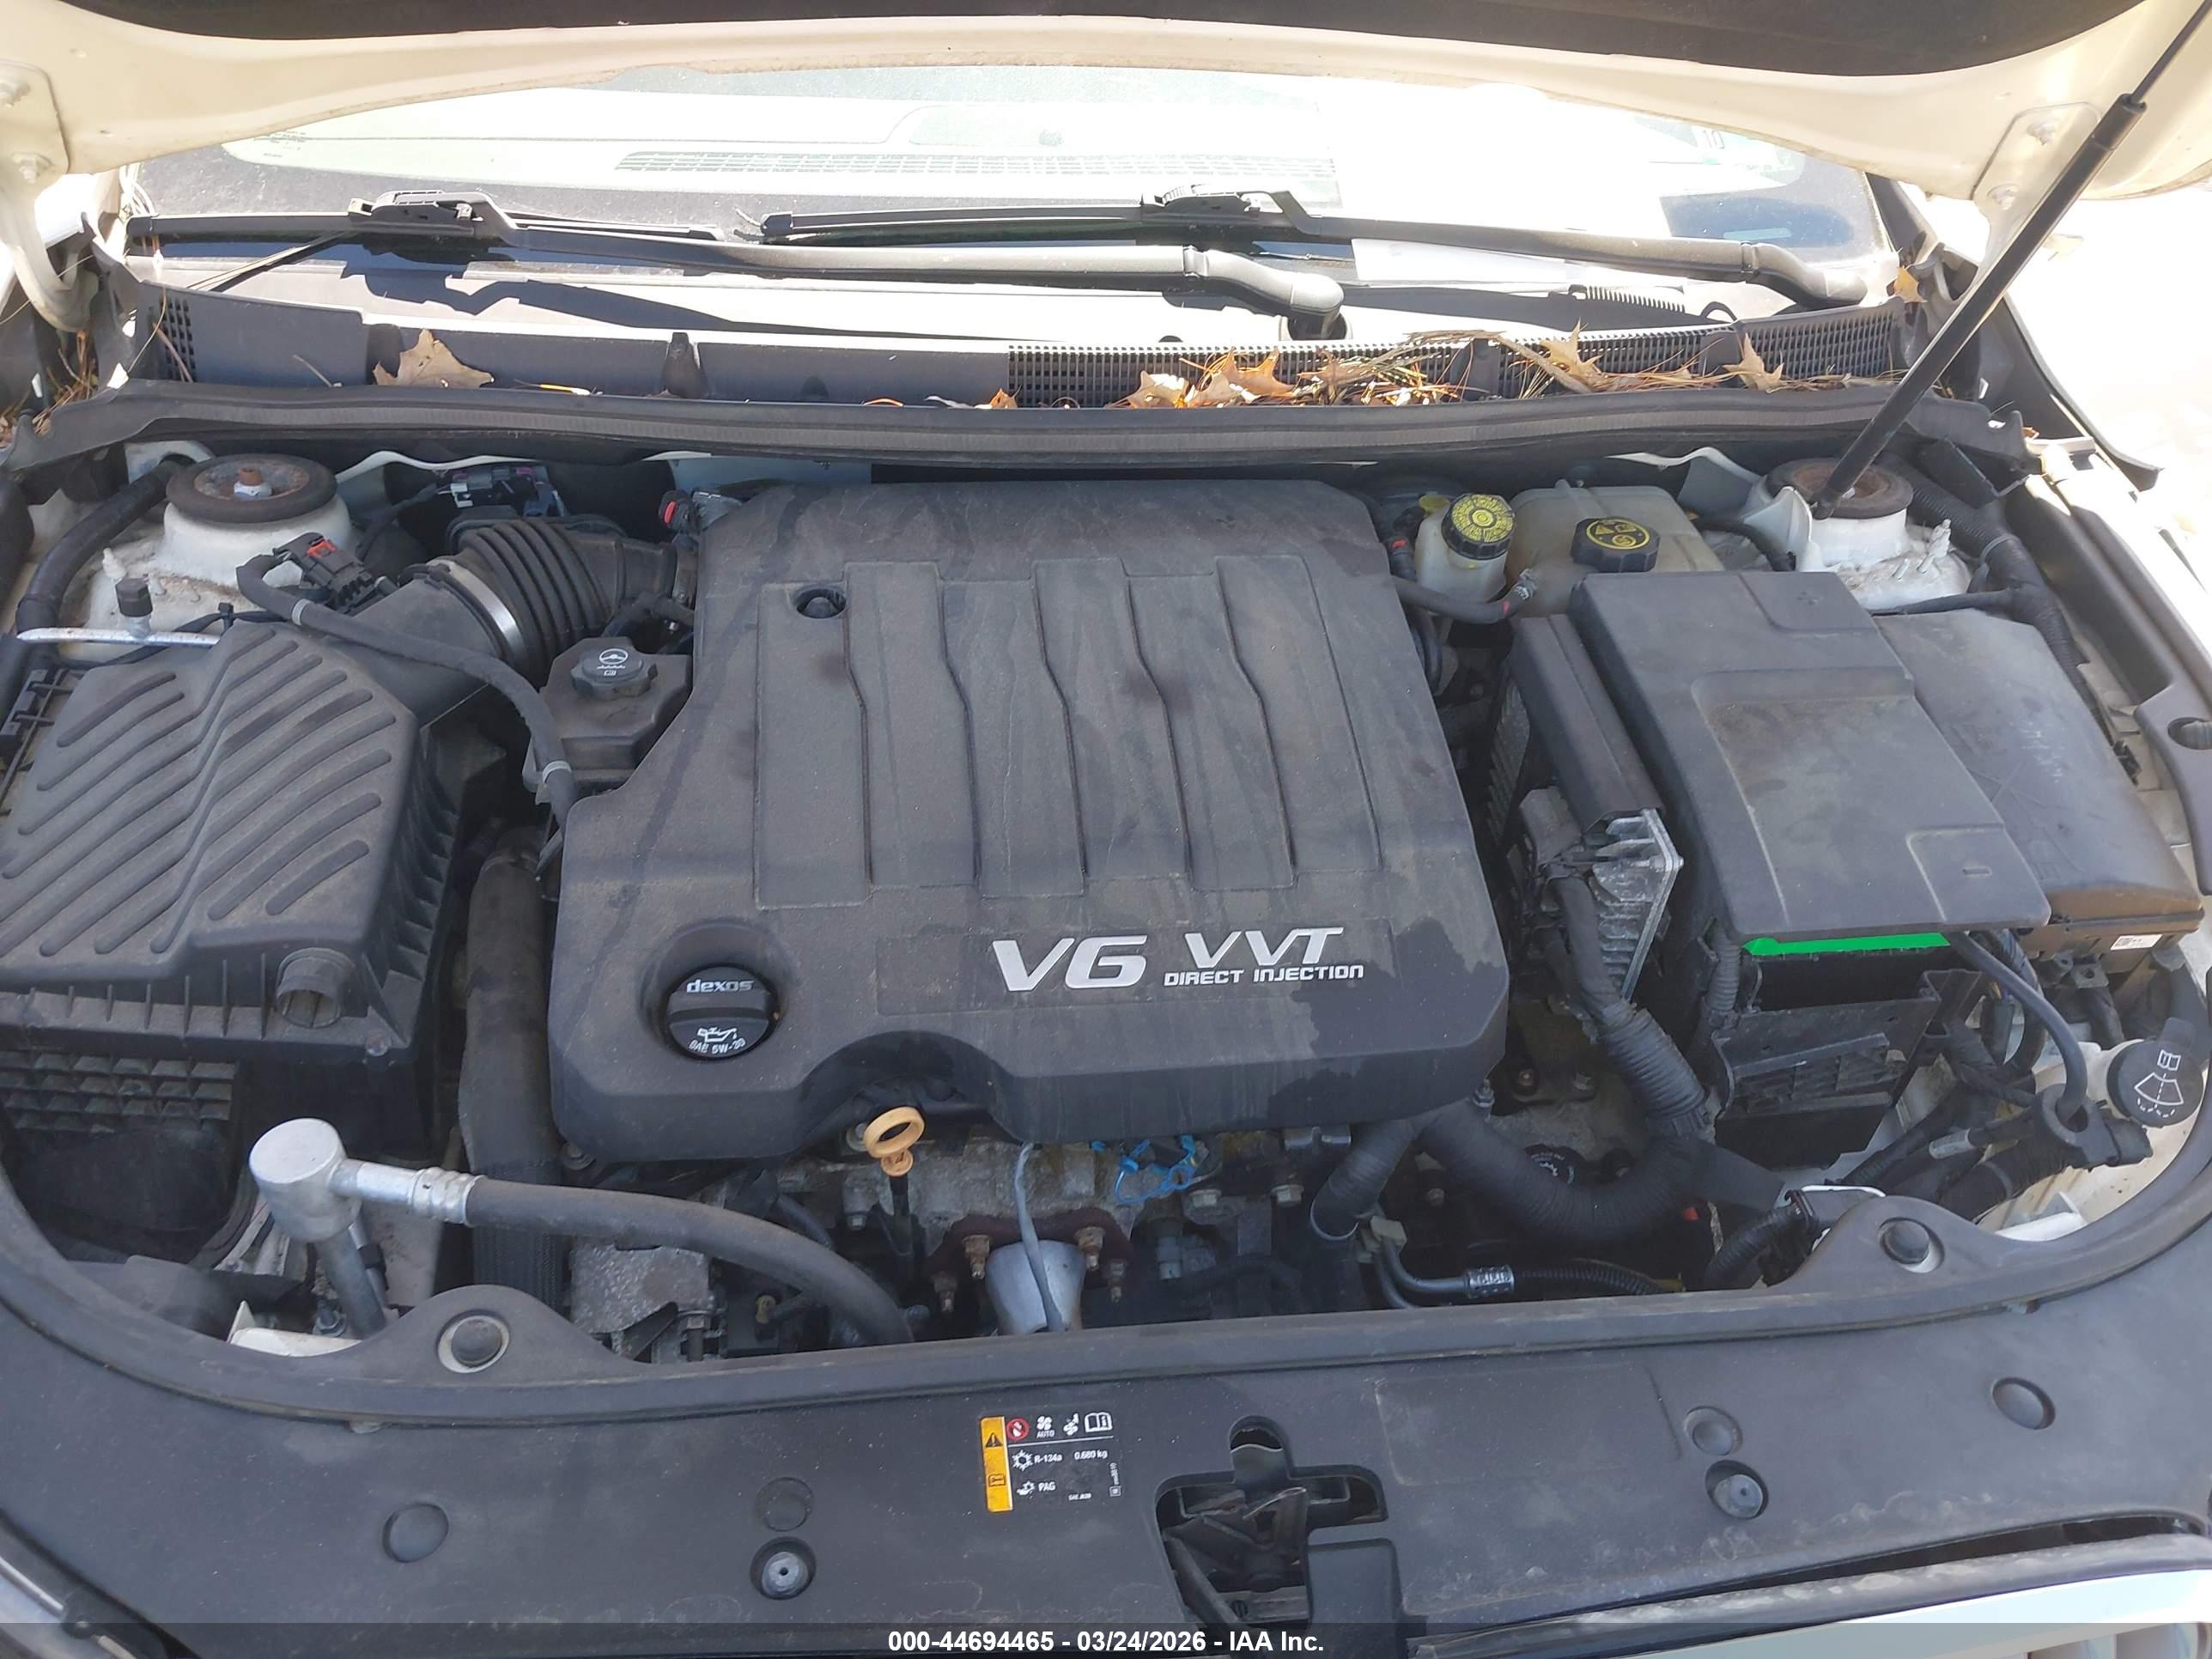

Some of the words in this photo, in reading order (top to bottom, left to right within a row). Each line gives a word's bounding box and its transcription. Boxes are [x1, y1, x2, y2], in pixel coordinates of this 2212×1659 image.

[992, 934, 1148, 991] V6
[1184, 927, 1344, 969] VVT
[1164, 969, 1244, 988] DIRECT
[1253, 964, 1364, 983] INJECTION
[686, 979, 756, 993] dexos
[1097, 1449, 1109, 1459] kg
[1038, 1481, 1056, 1492] PAG
